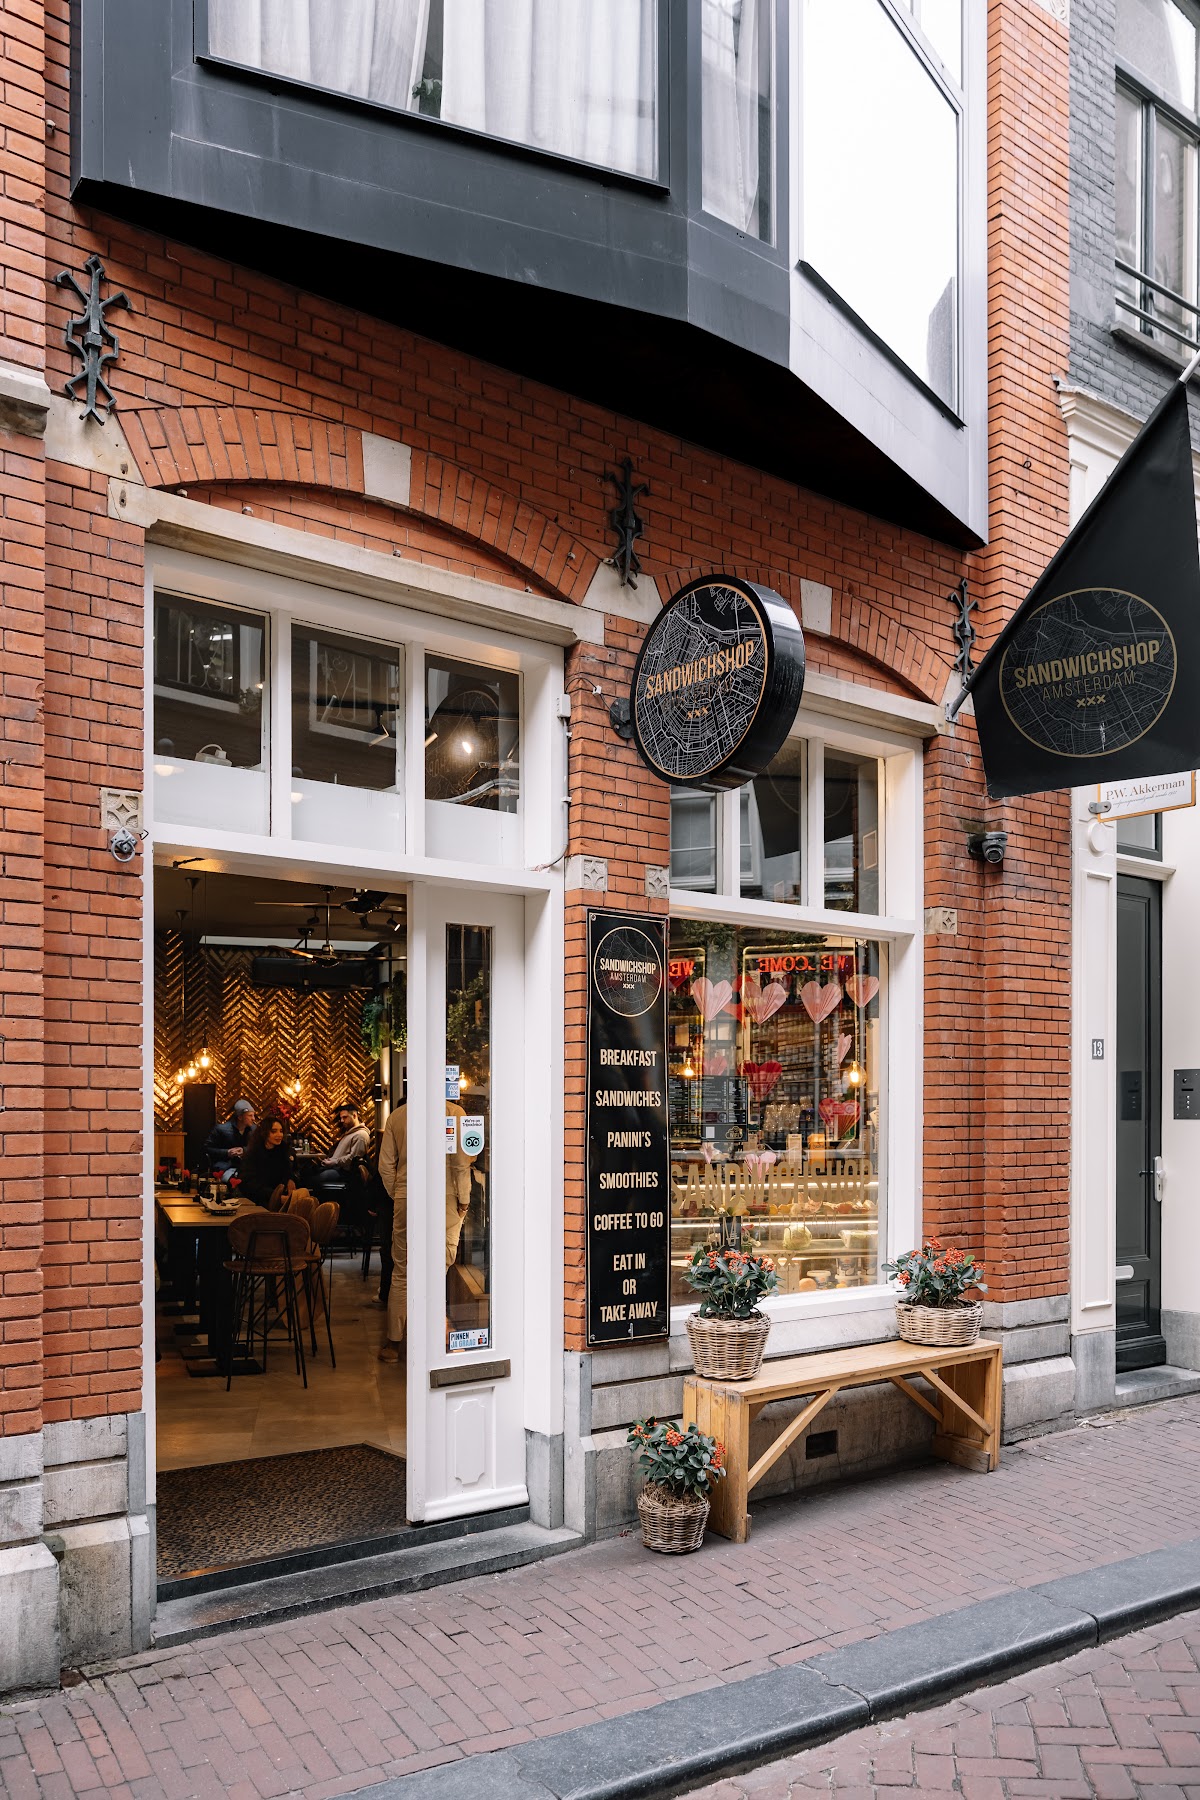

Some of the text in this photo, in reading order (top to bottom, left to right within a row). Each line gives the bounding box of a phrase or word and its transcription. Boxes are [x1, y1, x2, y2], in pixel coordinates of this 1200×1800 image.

[645, 639, 755, 699] SANDWICHSHOP
[1014, 639, 1160, 689] SANDWICHSHOP
[1042, 671, 1136, 701] AMSTERDAM
[1129, 779, 1185, 797] Akkerman
[599, 957, 656, 975] SANDWICHSHOP
[610, 972, 647, 983] AMSTERDAM
[600, 1048, 657, 1067] BREAKFAST
[1092, 1041, 1103, 1057] 13
[595, 1090, 661, 1107] SANDWICHES
[607, 1131, 652, 1148] PANINI'S
[599, 1171, 659, 1190] SMOOTHIES
[594, 1211, 664, 1231] COFFEE TO GO
[613, 1252, 646, 1271] EAT IN
[622, 1278, 637, 1296] OR
[600, 1301, 658, 1323] TAKE AWAY
[451, 1332, 470, 1341] PINNEN
